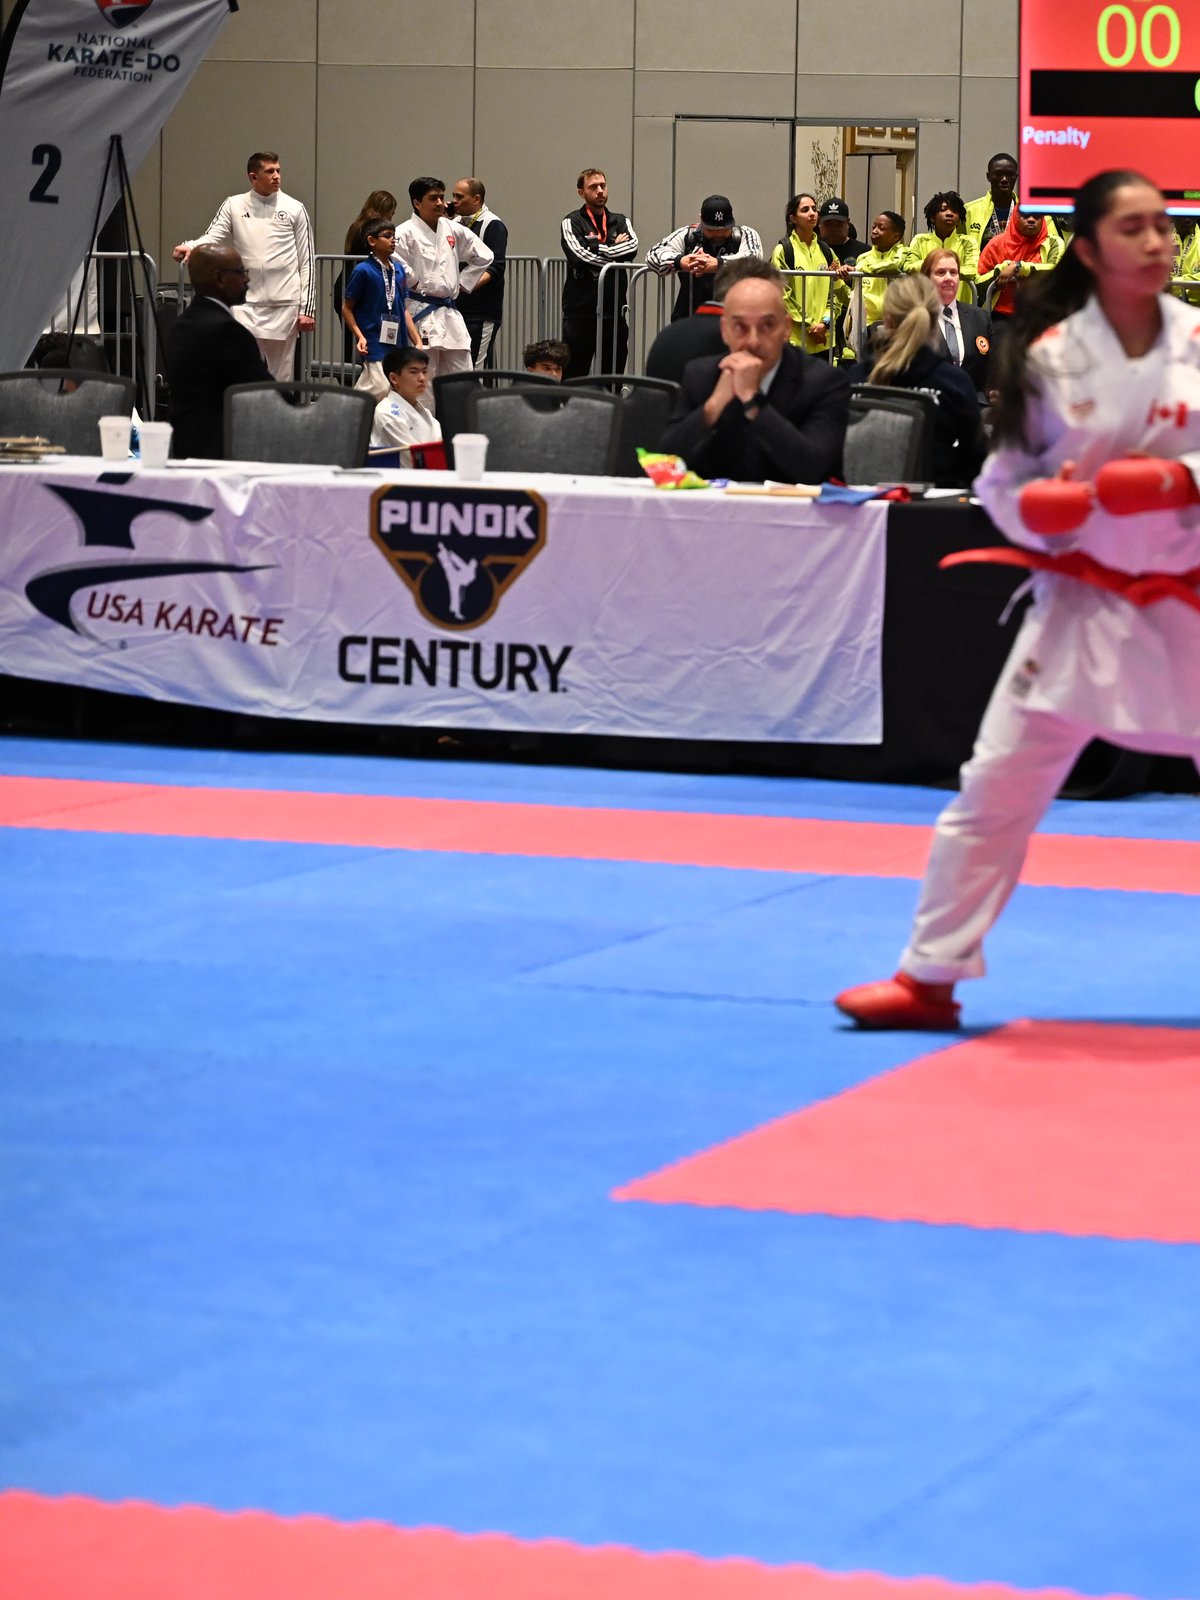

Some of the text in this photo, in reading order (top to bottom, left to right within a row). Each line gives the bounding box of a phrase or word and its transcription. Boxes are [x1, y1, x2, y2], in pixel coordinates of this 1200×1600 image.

[77, 32, 155, 50] NATIONAL
[1096, 4, 1181, 68] 00
[47, 44, 181, 73] KARATE-DO
[73, 66, 153, 83] FEDERATION
[1022, 126, 1091, 149] Penalty
[29, 143, 62, 204] 2
[380, 500, 536, 540] PUNOK
[87, 591, 285, 647] USA KARATE
[338, 635, 574, 693] CENTURY
